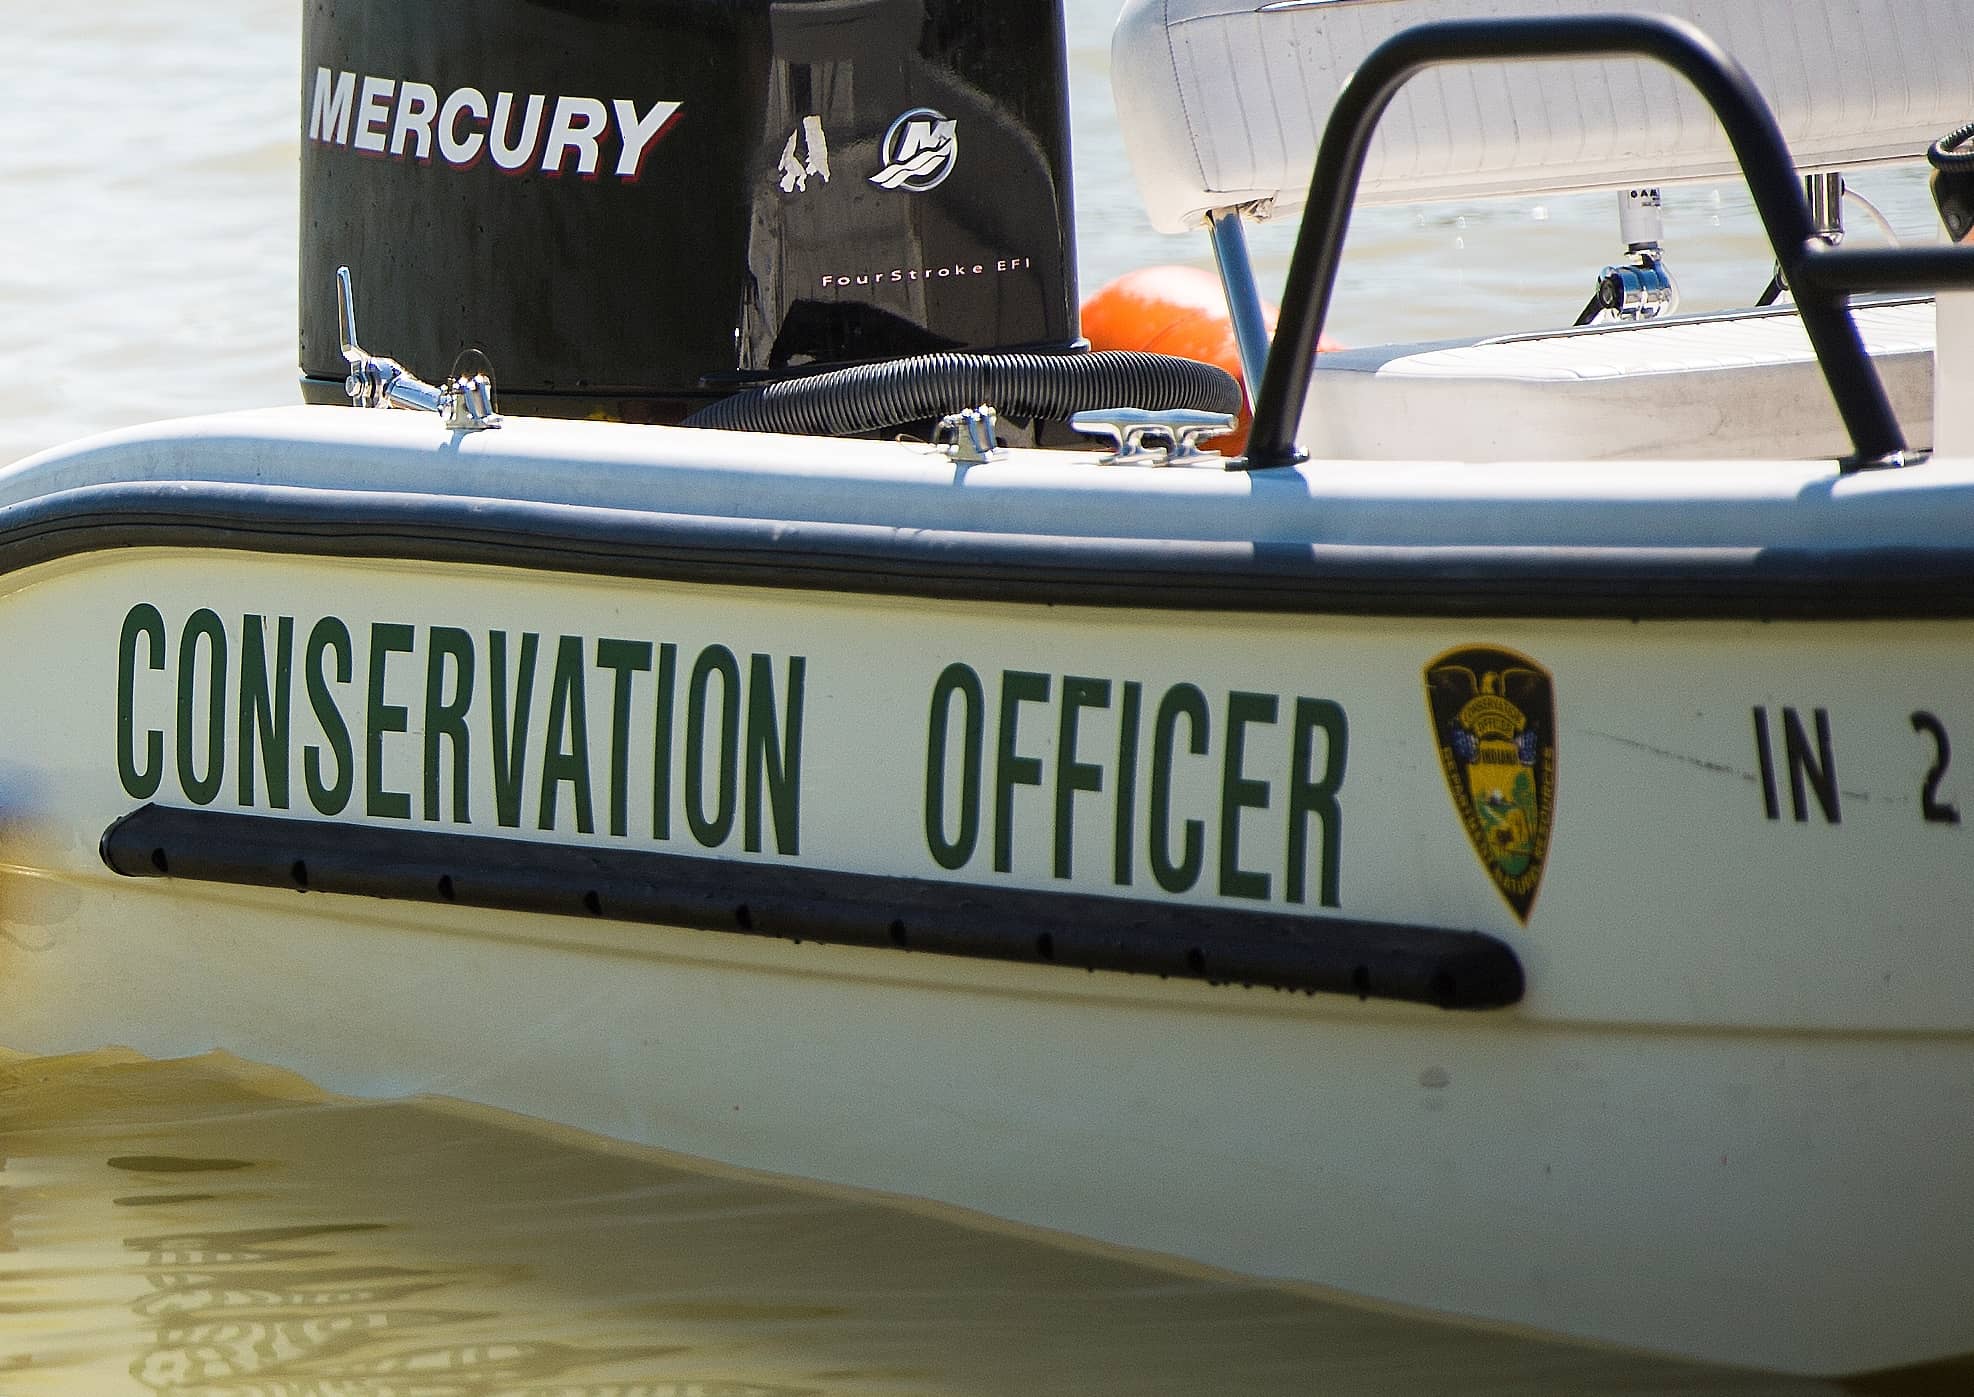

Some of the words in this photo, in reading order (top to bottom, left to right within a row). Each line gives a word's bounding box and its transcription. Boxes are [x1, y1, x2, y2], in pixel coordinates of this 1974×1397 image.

[309, 66, 684, 180] MERCURY
[821, 263, 984, 288] FourStroke
[997, 257, 1031, 272] EFI
[115, 602, 807, 856] CONSERVATION
[924, 661, 1350, 908] OFFICER
[1753, 704, 1842, 824] IN
[1910, 710, 1962, 824] 2
